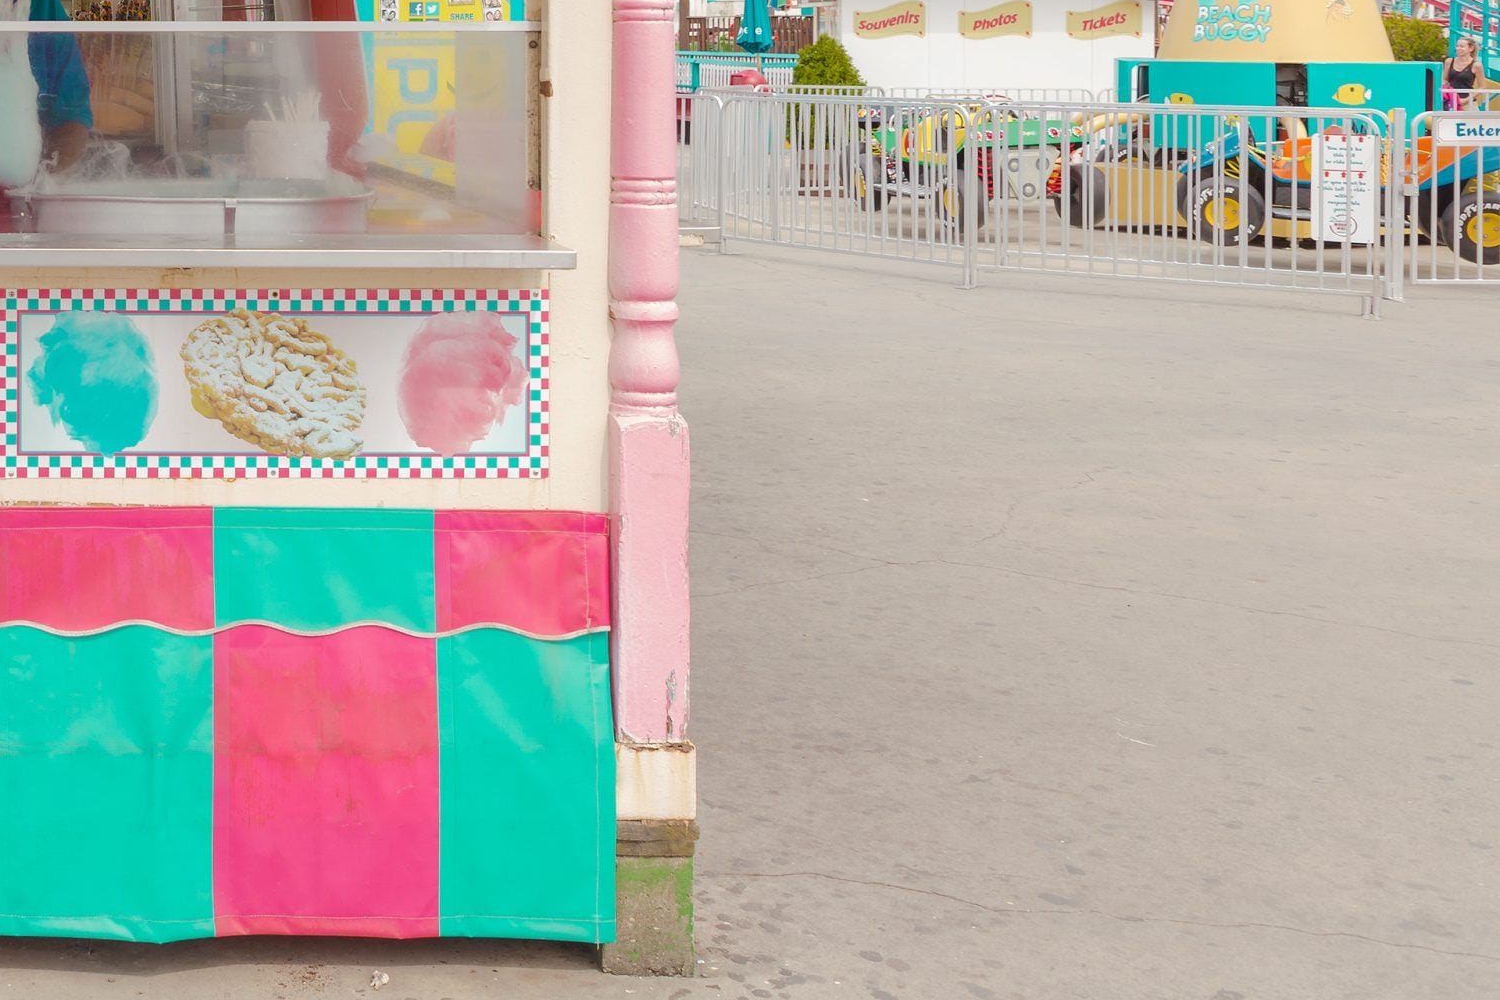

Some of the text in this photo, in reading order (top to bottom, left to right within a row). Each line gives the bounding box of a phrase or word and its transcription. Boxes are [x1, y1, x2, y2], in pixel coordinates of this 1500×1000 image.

[450, 12, 474, 21] SHARE
[858, 10, 921, 31] Souvenirs
[972, 12, 1019, 32] Photos
[1081, 11, 1127, 32] Tickets
[1196, 4, 1272, 24] BEACH
[1192, 23, 1272, 43] BUGGY
[1455, 122, 1500, 137] Enter
